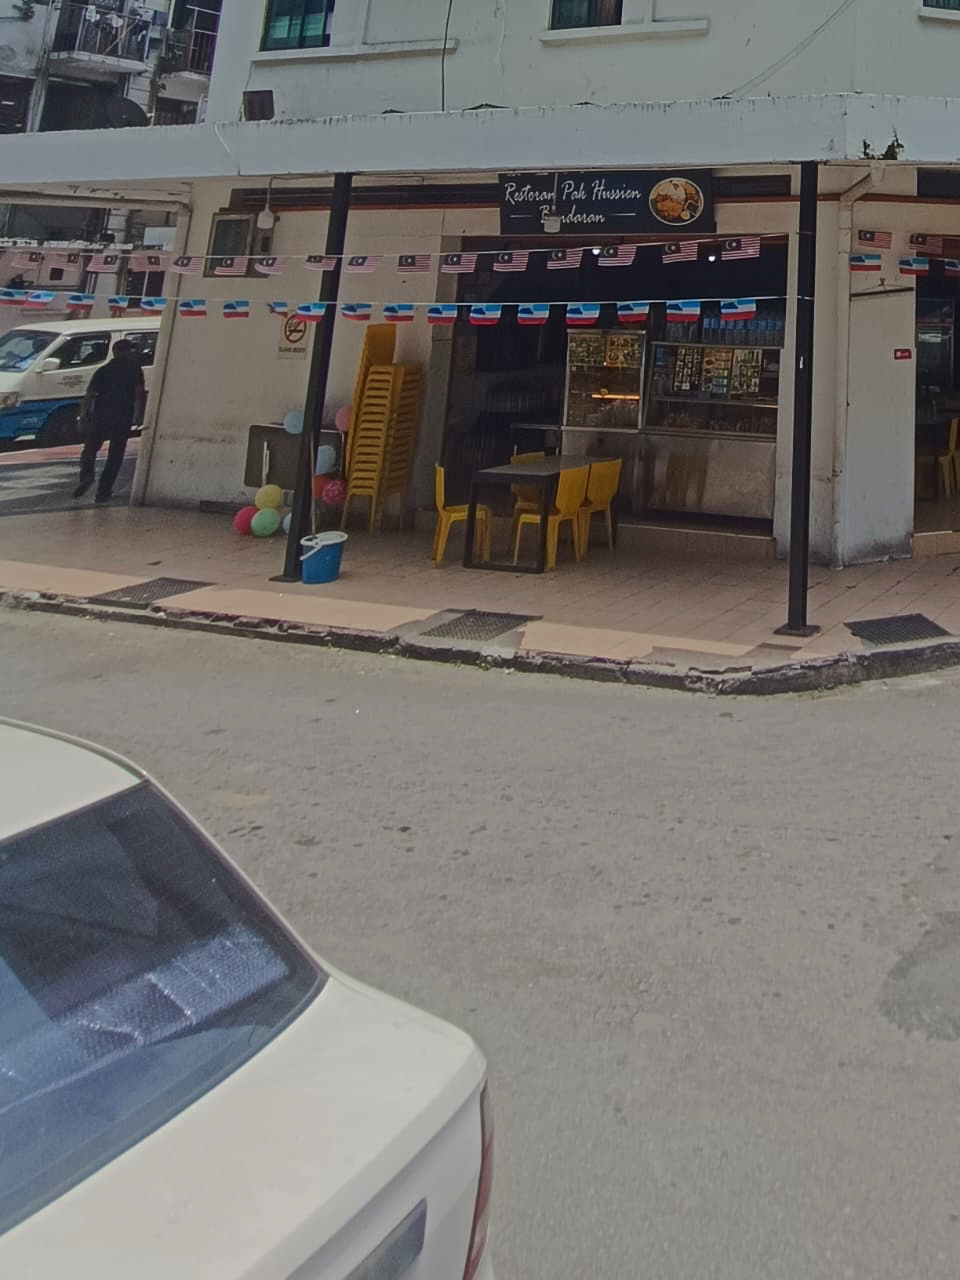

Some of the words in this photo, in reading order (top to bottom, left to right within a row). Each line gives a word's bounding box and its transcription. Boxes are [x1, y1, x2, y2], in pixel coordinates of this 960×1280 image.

[504, 182, 557, 205] Restoran
[560, 179, 588, 201] Pak
[591, 177, 642, 201] Hussien
[538, 204, 606, 224] Bndaran
